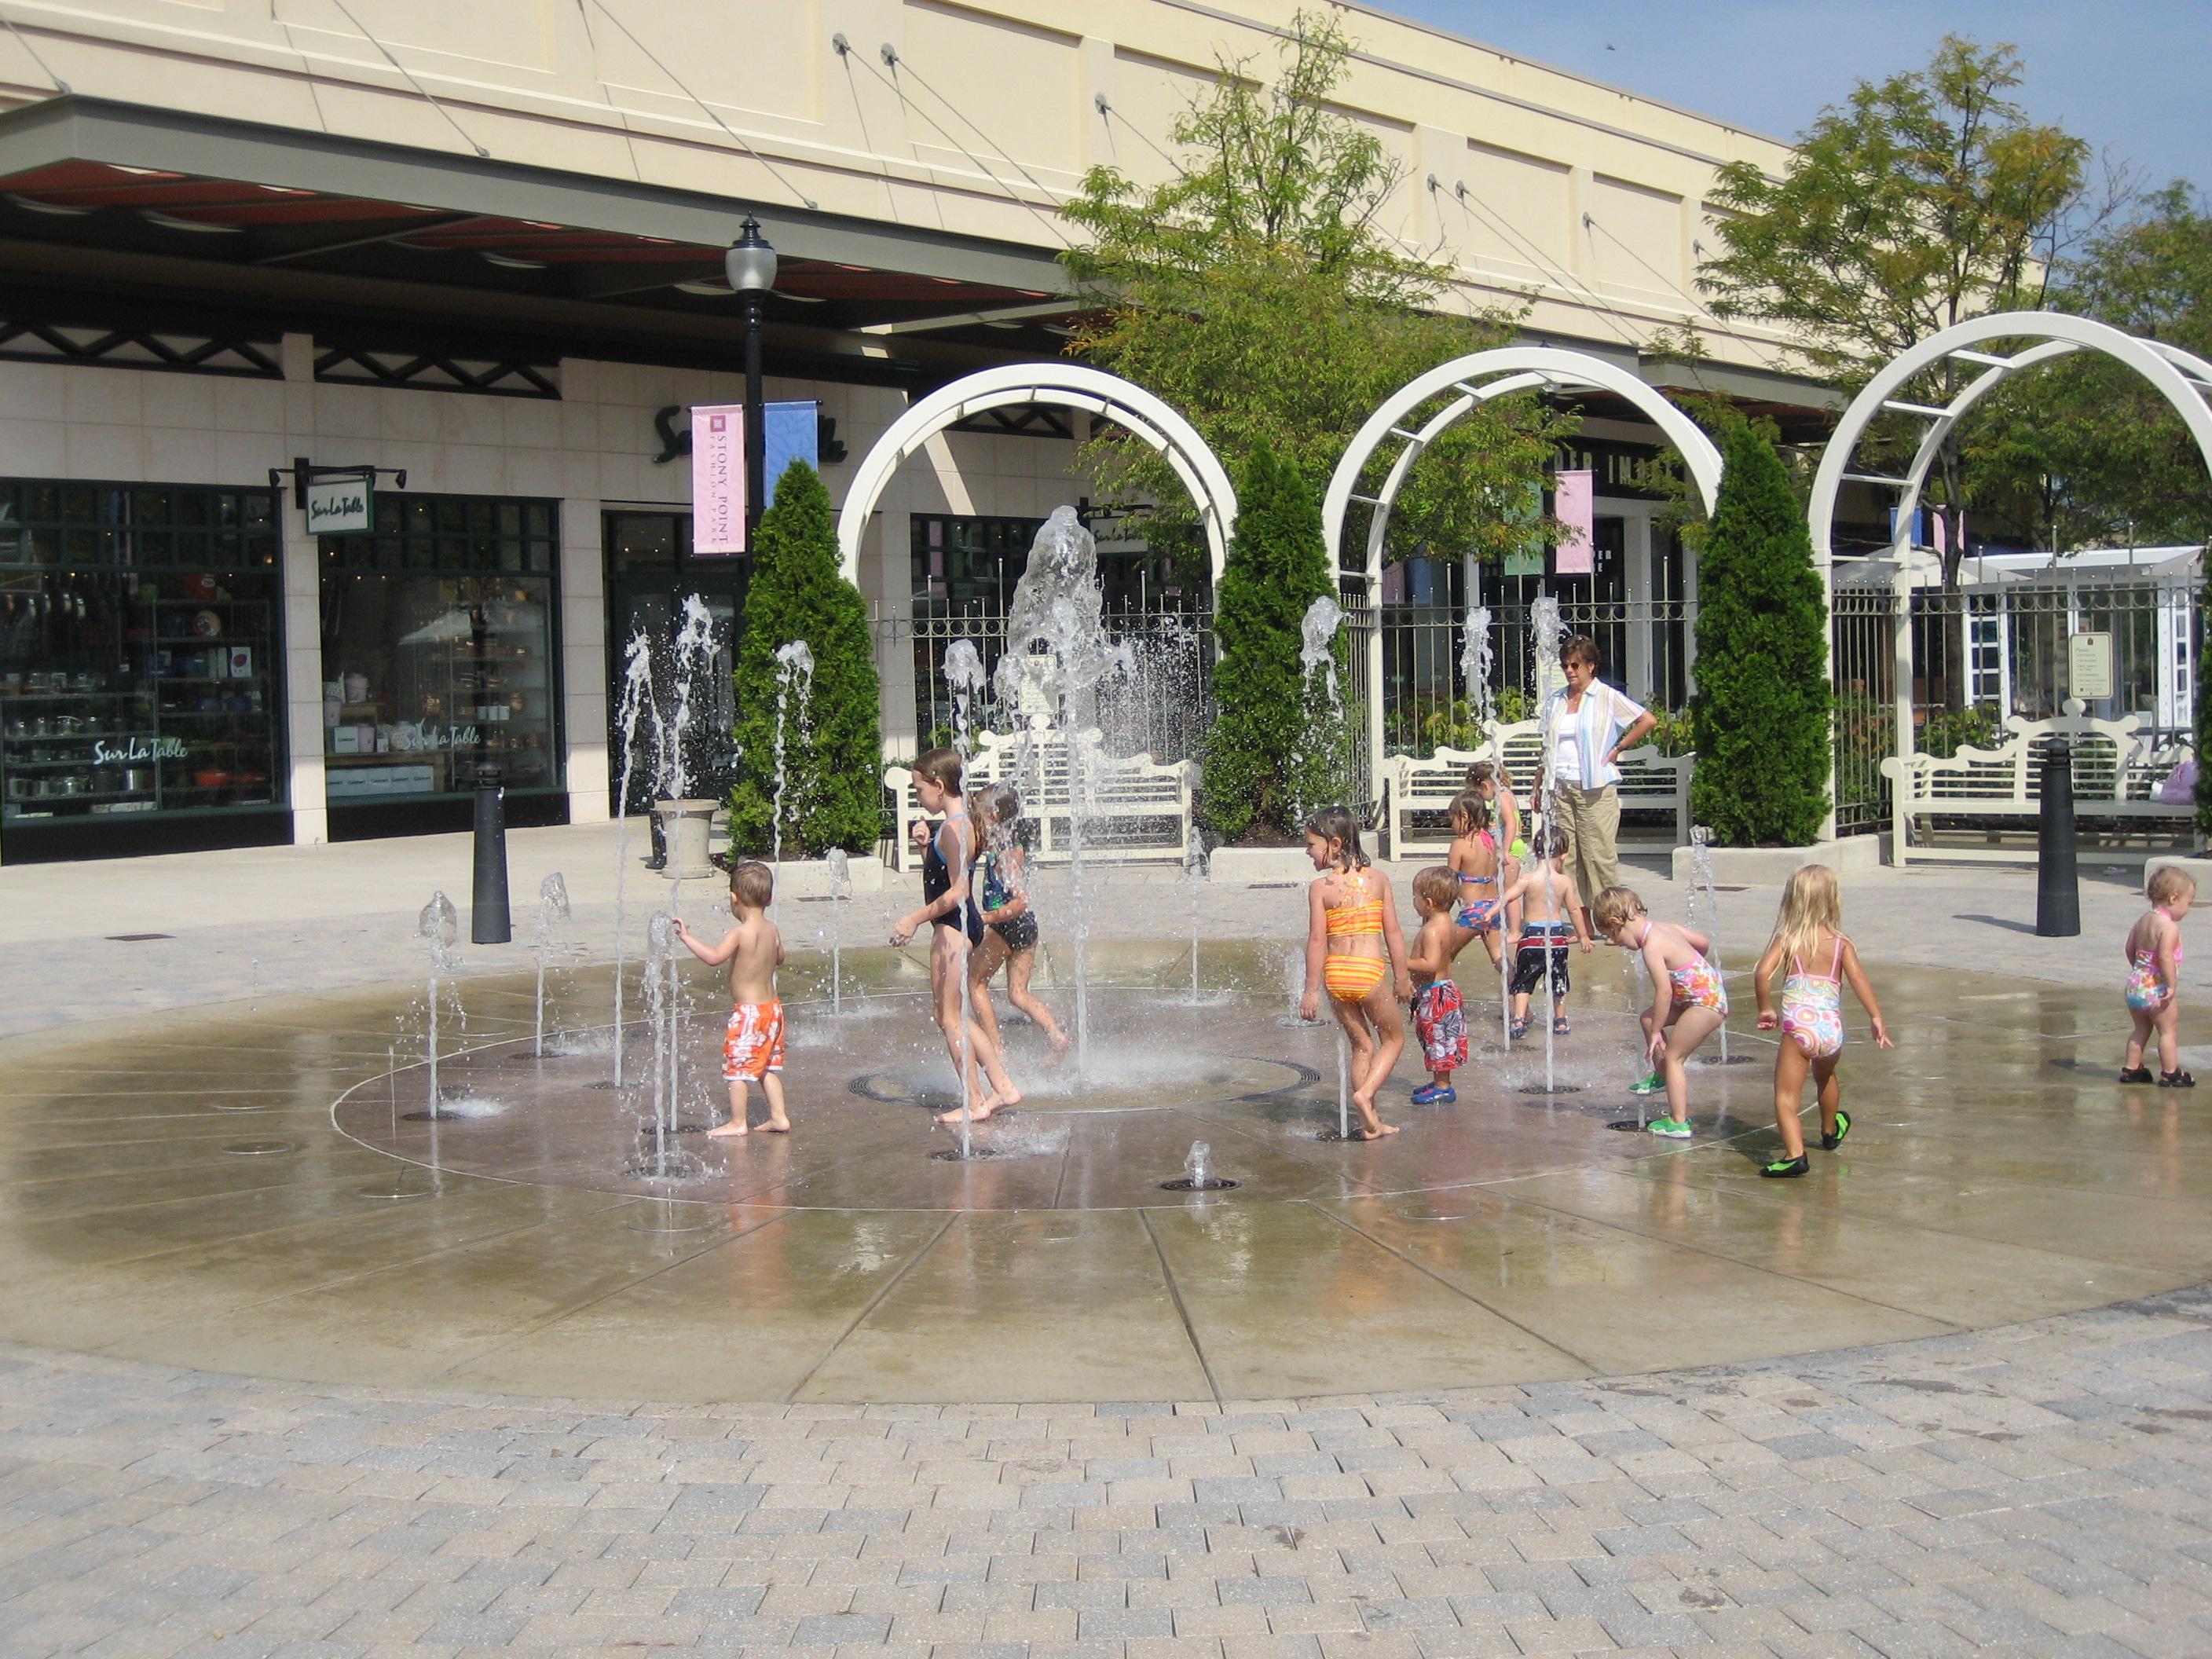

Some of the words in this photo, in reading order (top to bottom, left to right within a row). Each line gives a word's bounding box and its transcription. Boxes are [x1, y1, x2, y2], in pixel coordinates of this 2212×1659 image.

[716, 435, 728, 486] STONY
[328, 496, 342, 515] La
[342, 496, 364, 516] Table
[717, 496, 729, 544] POINT
[93, 740, 128, 765] Sur
[128, 737, 150, 760] La
[149, 738, 189, 762] Table
[449, 725, 482, 749] Table
